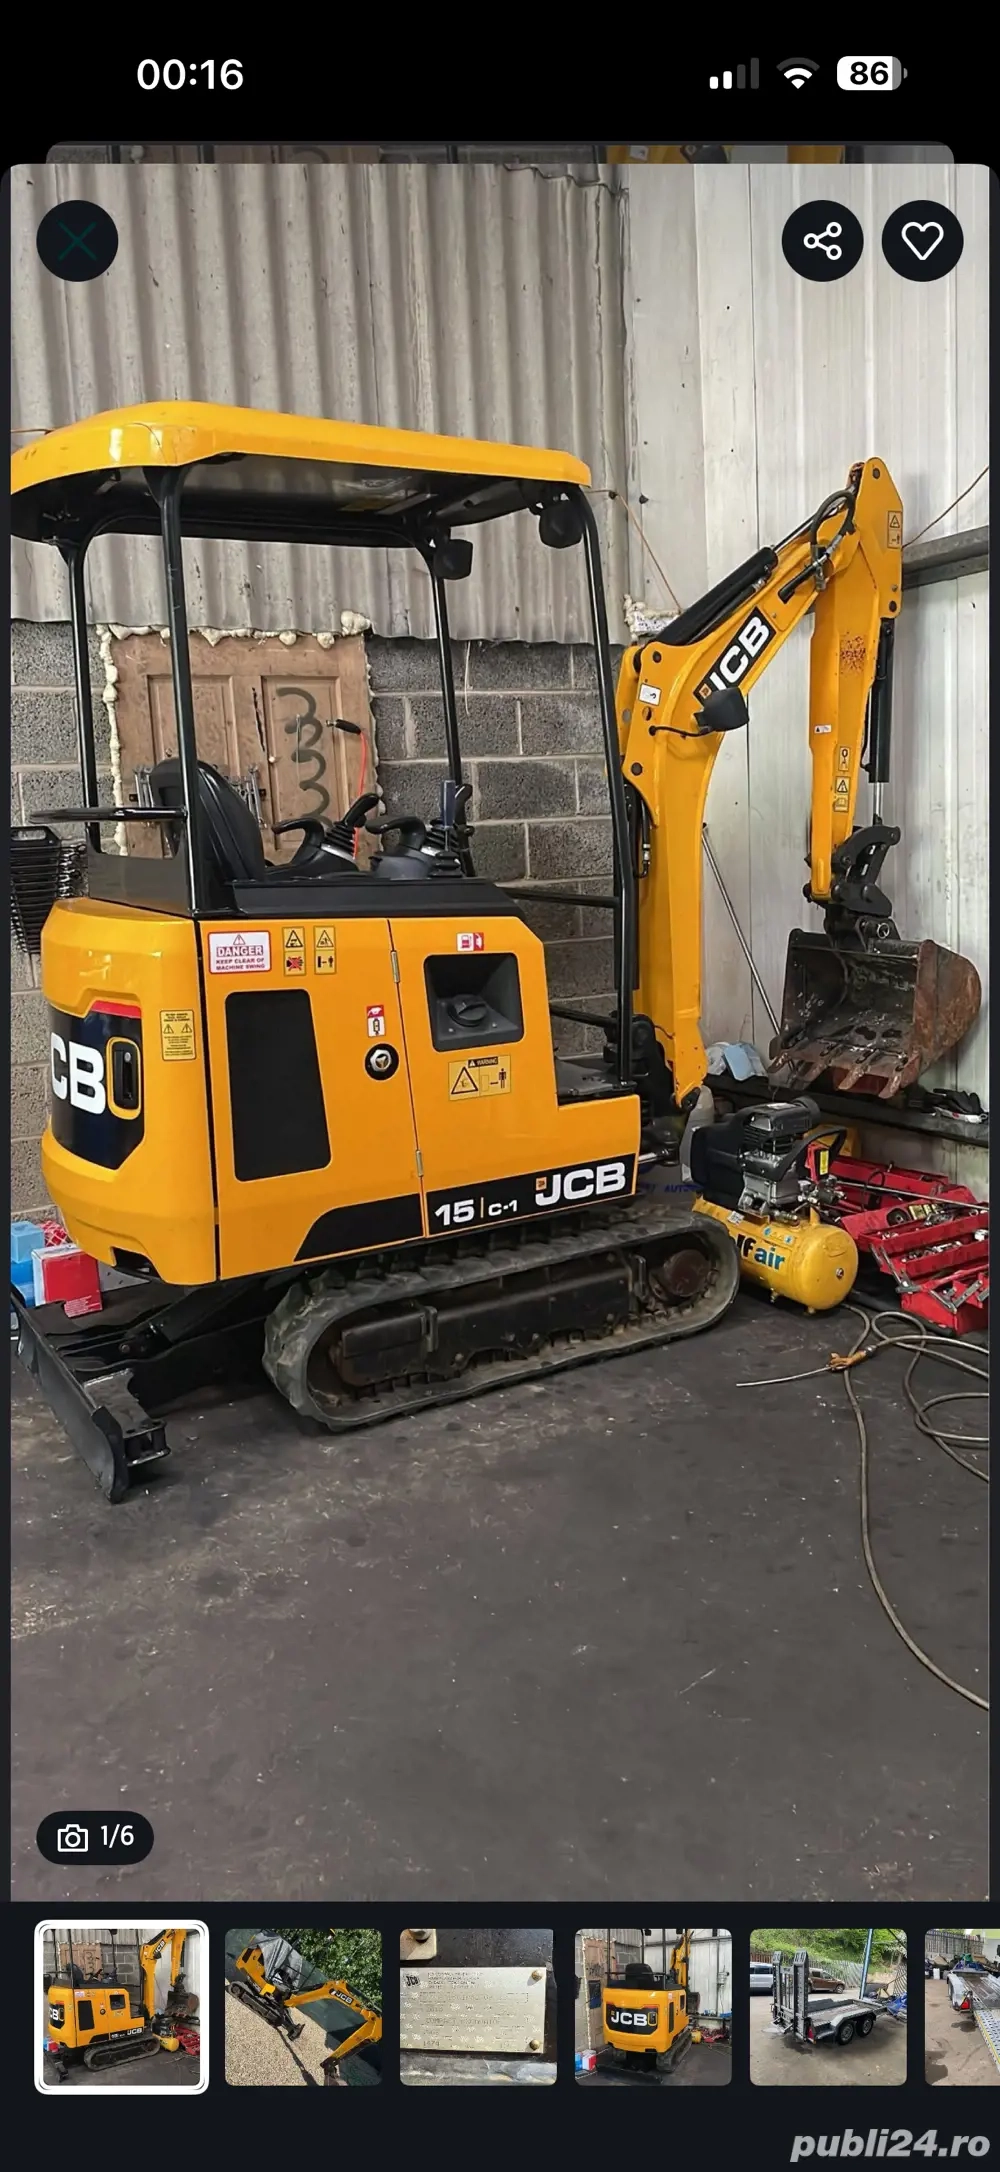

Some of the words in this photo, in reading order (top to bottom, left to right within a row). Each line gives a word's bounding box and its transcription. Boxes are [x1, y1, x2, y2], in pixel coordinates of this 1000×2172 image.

[137, 59, 244, 90] 00:16
[849, 62, 889, 86] 86
[216, 945, 263, 957] DANGER
[51, 1032, 107, 1114] CB
[476, 1058, 498, 1066] WARNING
[535, 1161, 626, 1206] JCB
[435, 1199, 475, 1226] 15
[100, 1825, 135, 1848] 1/6
[611, 2011, 648, 2026] JCB
